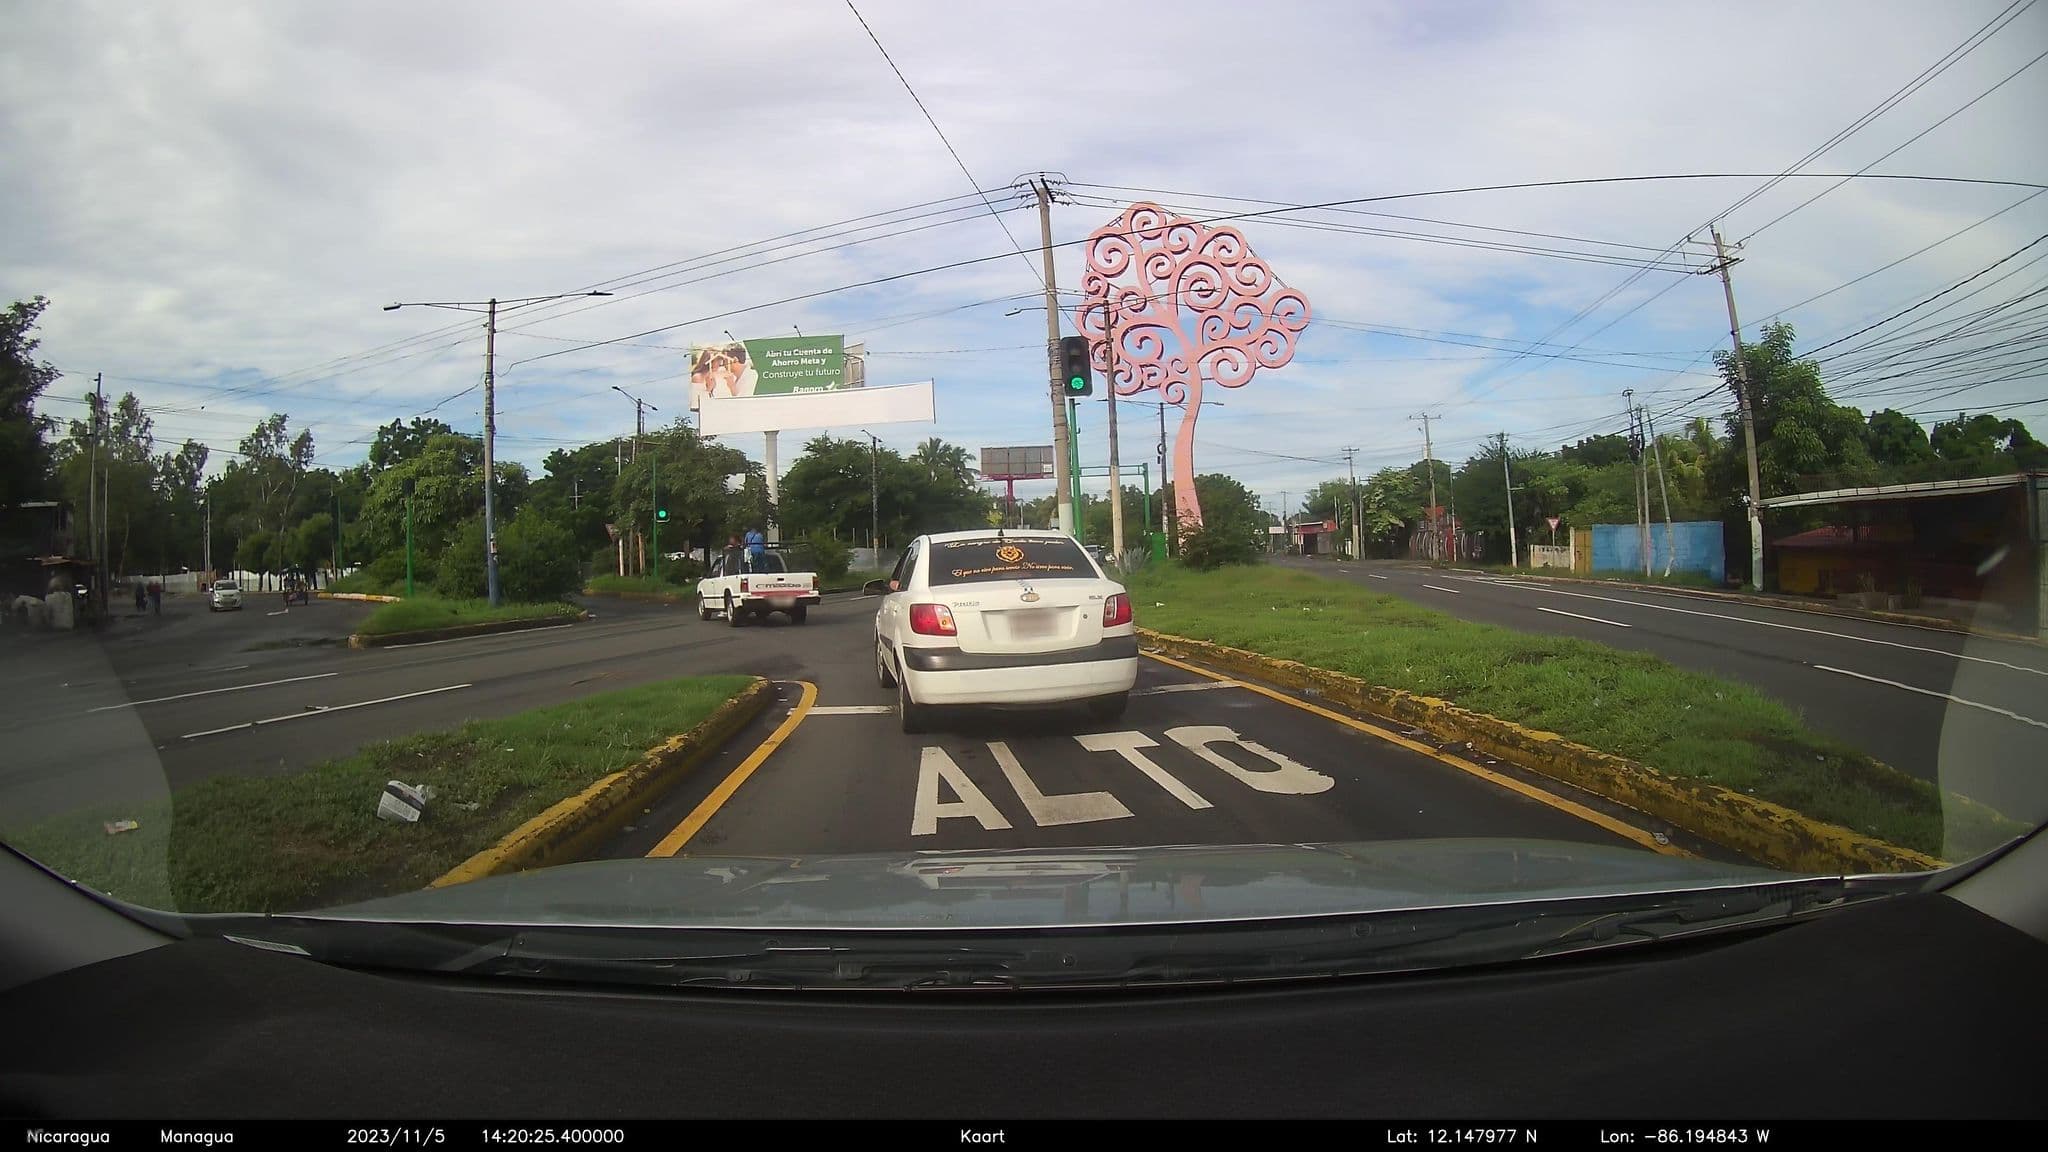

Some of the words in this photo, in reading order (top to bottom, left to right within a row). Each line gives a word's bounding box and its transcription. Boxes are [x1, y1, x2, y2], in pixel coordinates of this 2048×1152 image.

[793, 348, 821, 356] Cuenta
[772, 359, 800, 367] Ahorro
[800, 357, 821, 365] Meta
[821, 358, 827, 366] y
[762, 370, 804, 379] Construye
[805, 368, 814, 377] tu
[815, 367, 841, 376] futuro
[911, 725, 1335, 836] ALTO
